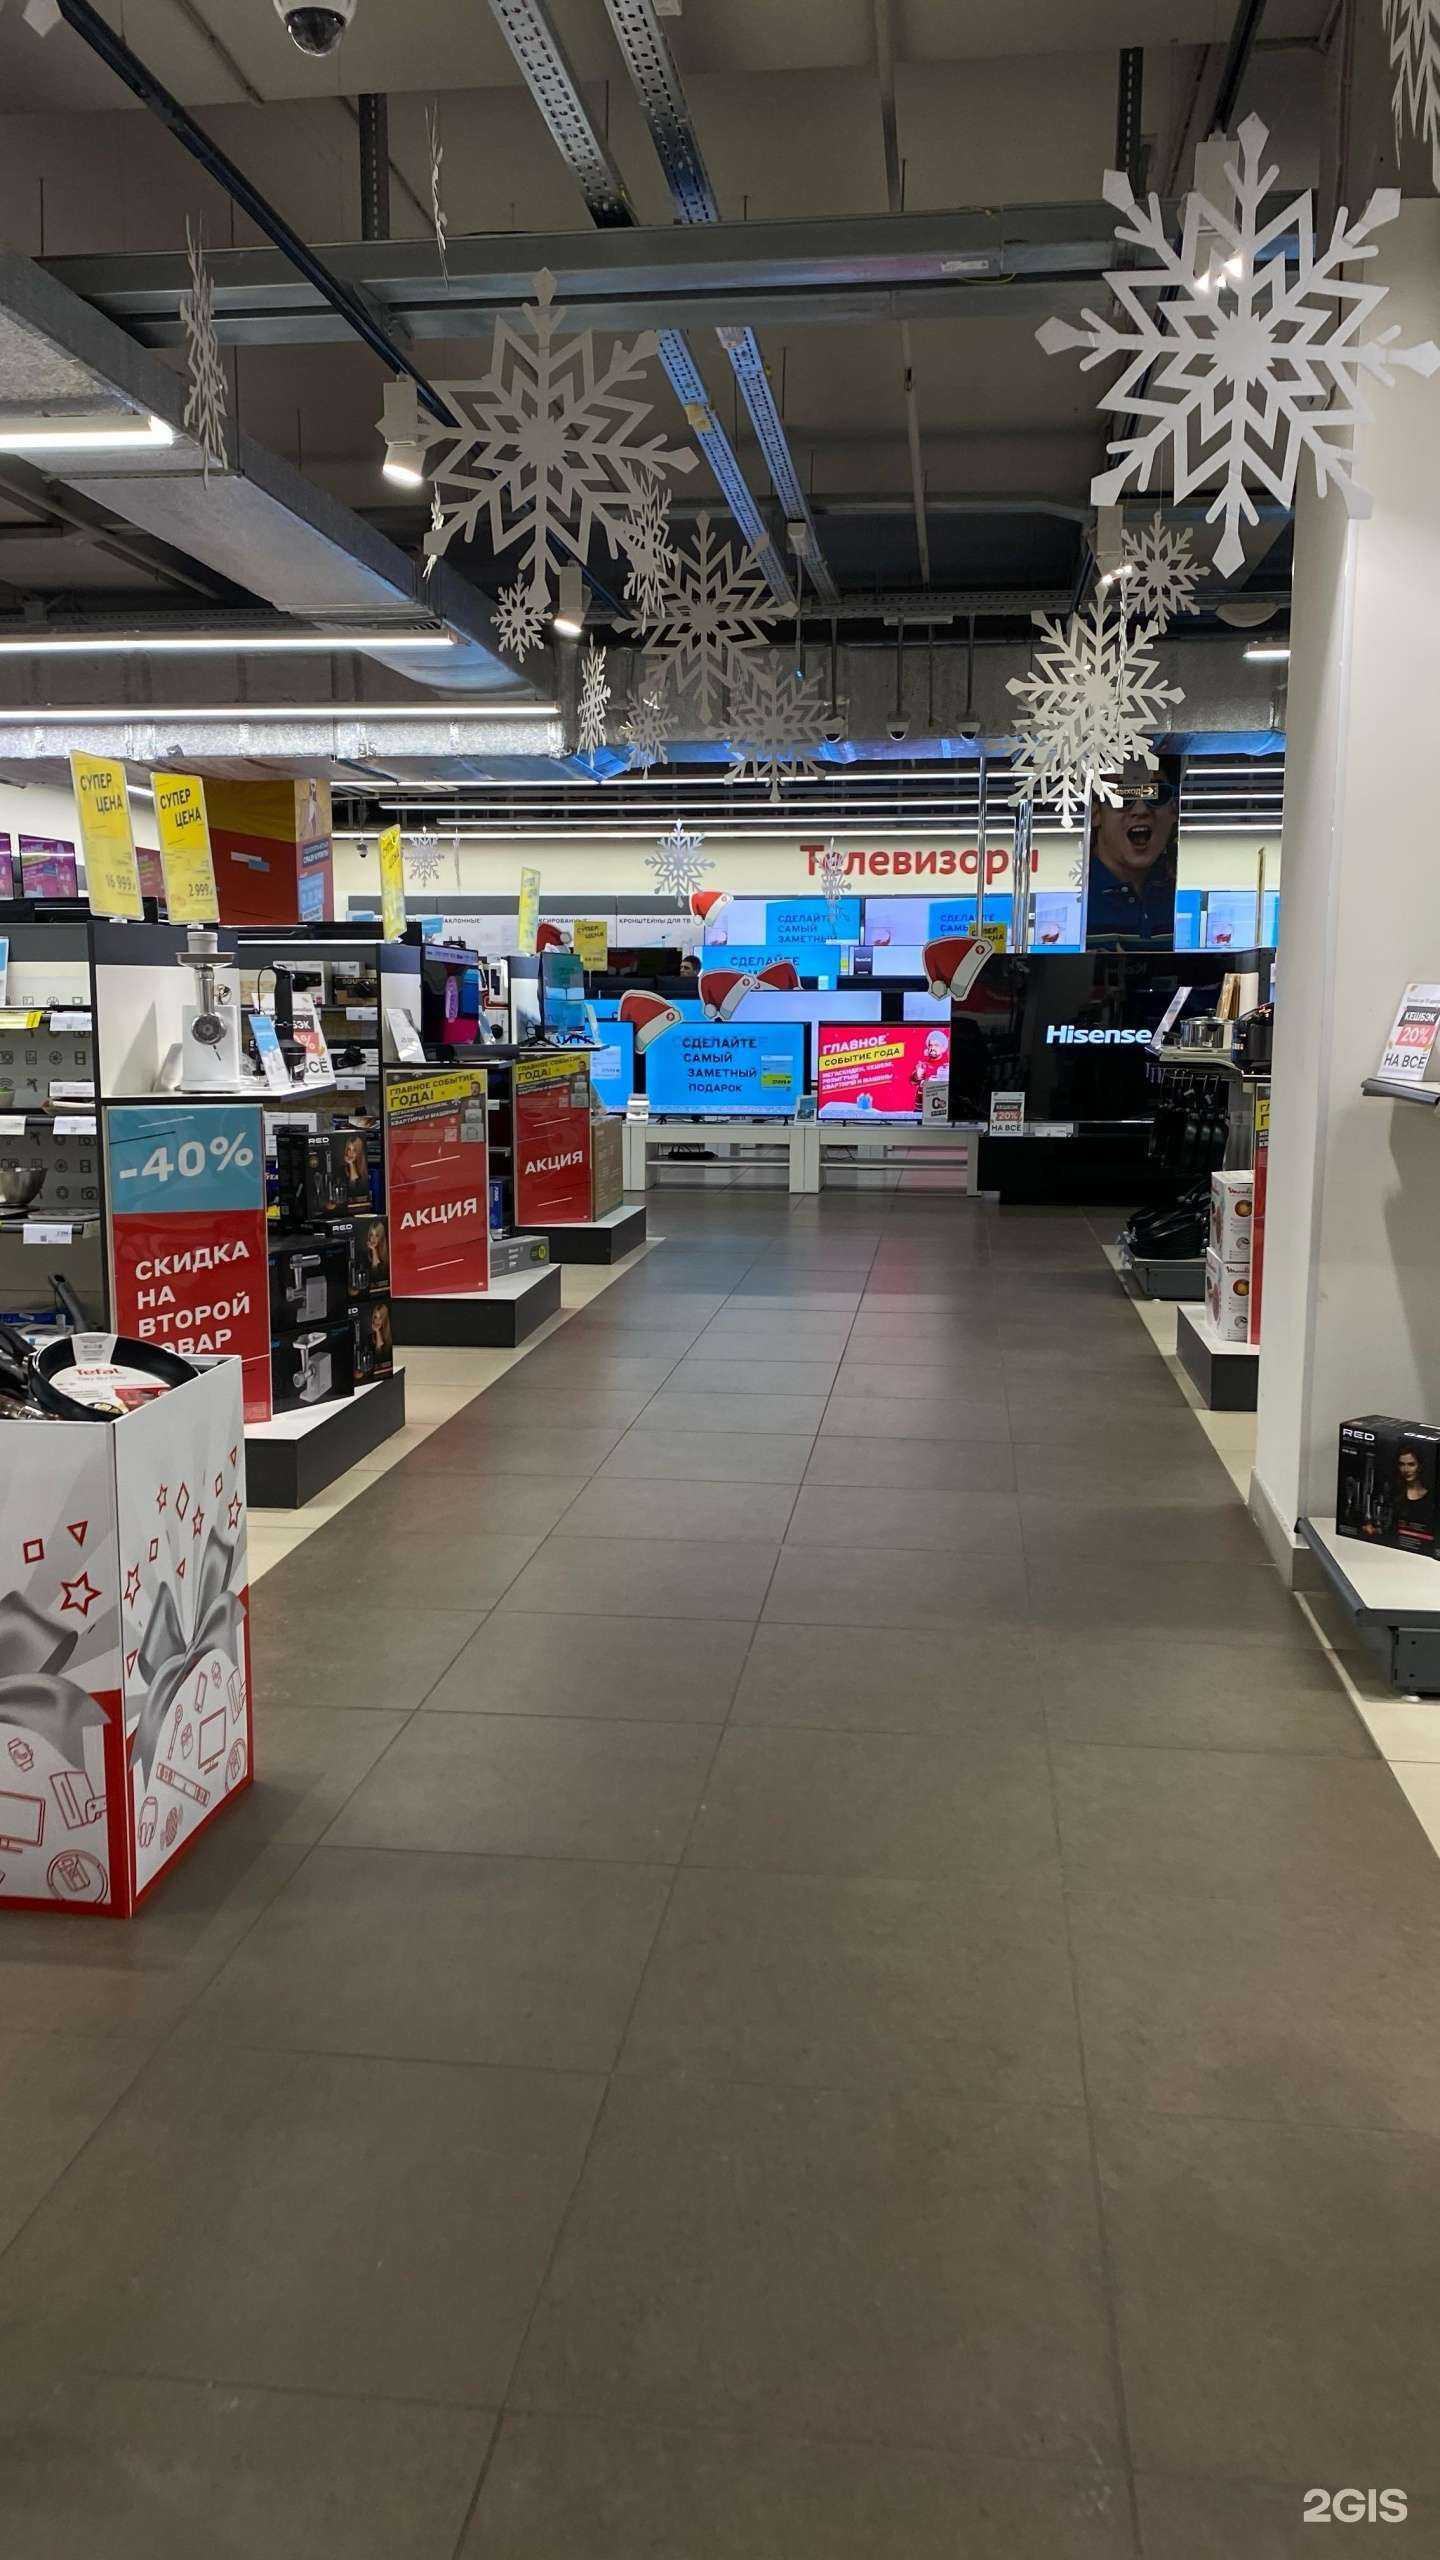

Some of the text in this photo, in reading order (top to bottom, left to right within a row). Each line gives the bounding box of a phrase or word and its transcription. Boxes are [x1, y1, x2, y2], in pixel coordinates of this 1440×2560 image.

[80, 773, 112, 791] СУПЕР
[96, 795, 123, 814] ЦЕНА
[160, 788, 191, 809] СУПЕР
[175, 807, 201, 828] ЦЕНА
[941, 914, 994, 922] СДЕЛАТЕ
[777, 925, 817, 933] САМЫЙ
[1404, 1011, 1438, 1023] КЕШБЭК
[682, 1036, 758, 1049] СДЕЛАЙТЕ
[1046, 1025, 1153, 1044] Hisense
[1401, 1026, 1430, 1044] 20%
[823, 1034, 888, 1055] ГЛАВНОЕ
[304, 1058, 330, 1073] СЁ
[684, 1052, 733, 1063] САМЫЙ
[824, 1047, 901, 1067] СОБЫТИЕ ГОДА
[1384, 1053, 1400, 1067] НА
[518, 1069, 552, 1082] ГОДА!
[688, 1066, 758, 1078] ЗАМЕТНЫЙ
[389, 1073, 476, 1096] ГЛАВНОЕ СОБЫТИЕ
[688, 1083, 743, 1093] ПОДАРОК
[390, 1090, 435, 1108] ГОДА!
[991, 1124, 1004, 1132] НА
[308, 1137, 330, 1145] RED
[119, 1131, 254, 1184] -40%
[524, 1149, 583, 1176] АКЦИЯ
[400, 1197, 478, 1231] АКЦИЯ
[332, 1223, 353, 1232] RED
[135, 1240, 250, 1282] СКИДКА
[137, 1286, 176, 1310] НА
[138, 1291, 251, 1339] ВТОРОЙ
[1342, 1428, 1376, 1442] RED
